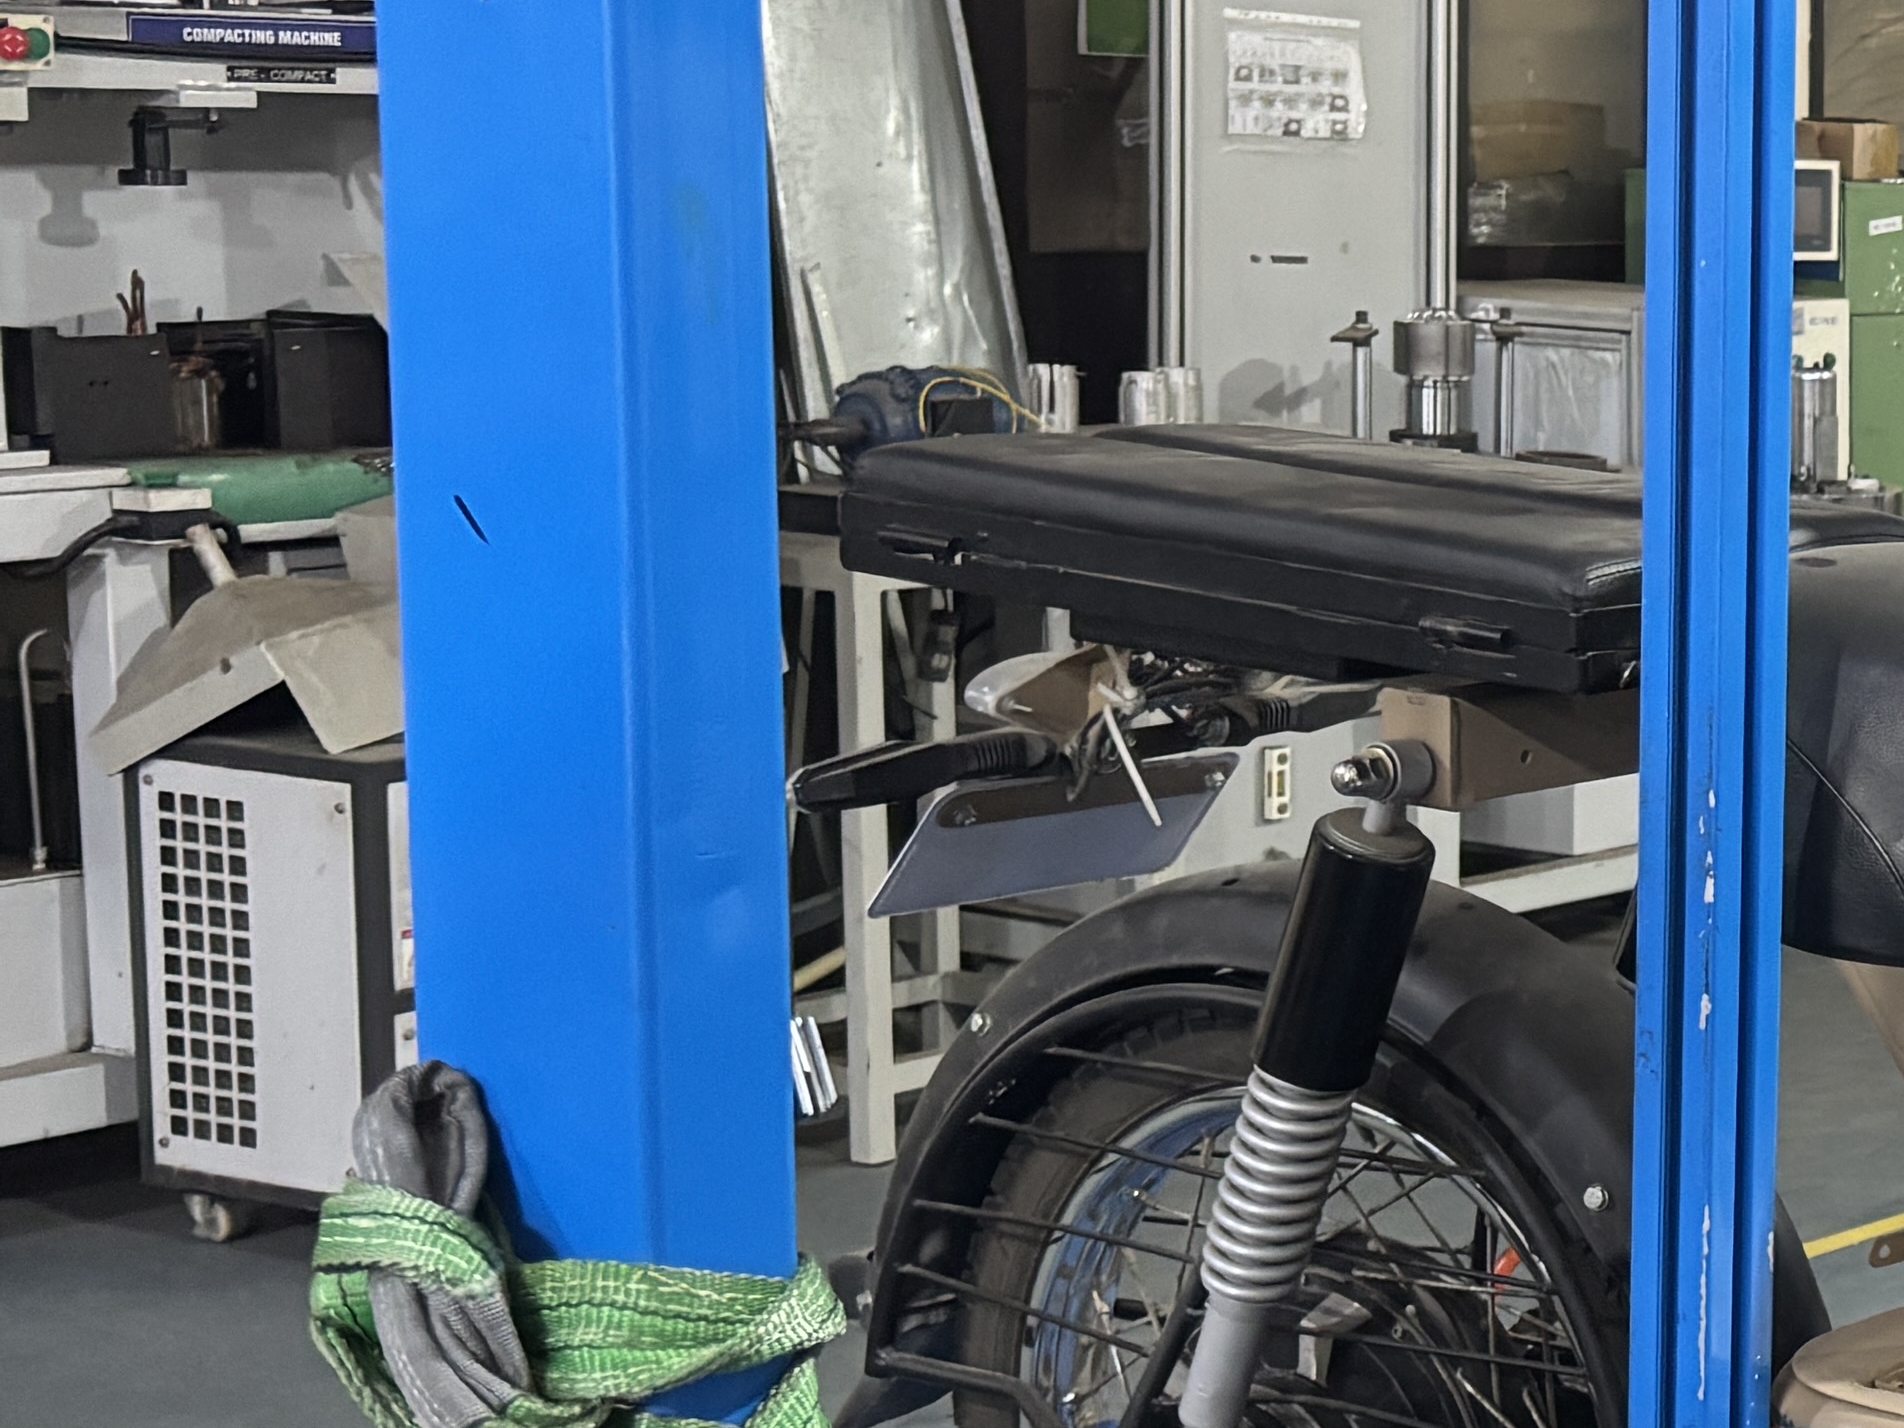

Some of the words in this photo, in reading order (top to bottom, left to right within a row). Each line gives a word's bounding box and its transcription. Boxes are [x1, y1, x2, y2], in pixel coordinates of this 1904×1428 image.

[182, 26, 275, 45] COMPACTING
[278, 30, 342, 47] MACHINE
[269, 69, 328, 82] COMPACT
